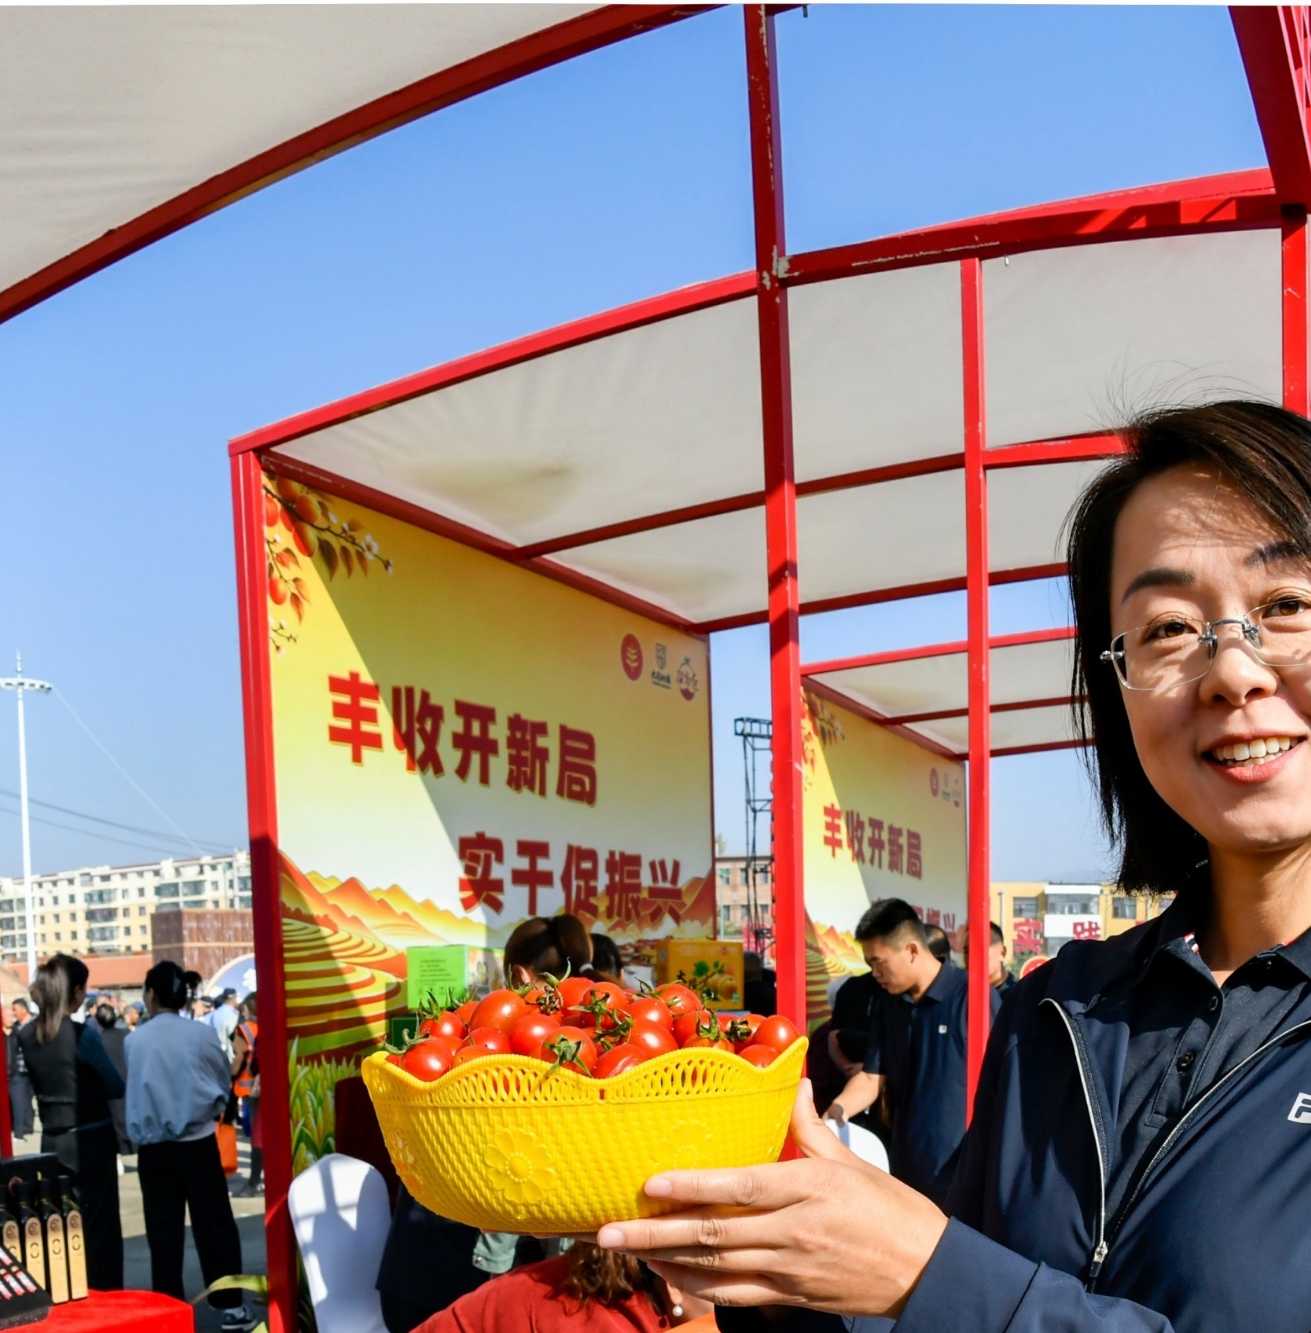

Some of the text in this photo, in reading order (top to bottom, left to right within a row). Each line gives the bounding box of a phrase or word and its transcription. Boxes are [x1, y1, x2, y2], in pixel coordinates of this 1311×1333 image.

[327, 670, 598, 806] 丰收开新局
[458, 831, 686, 925] 实干促振兴
[823, 803, 923, 880] 丰收开新局
